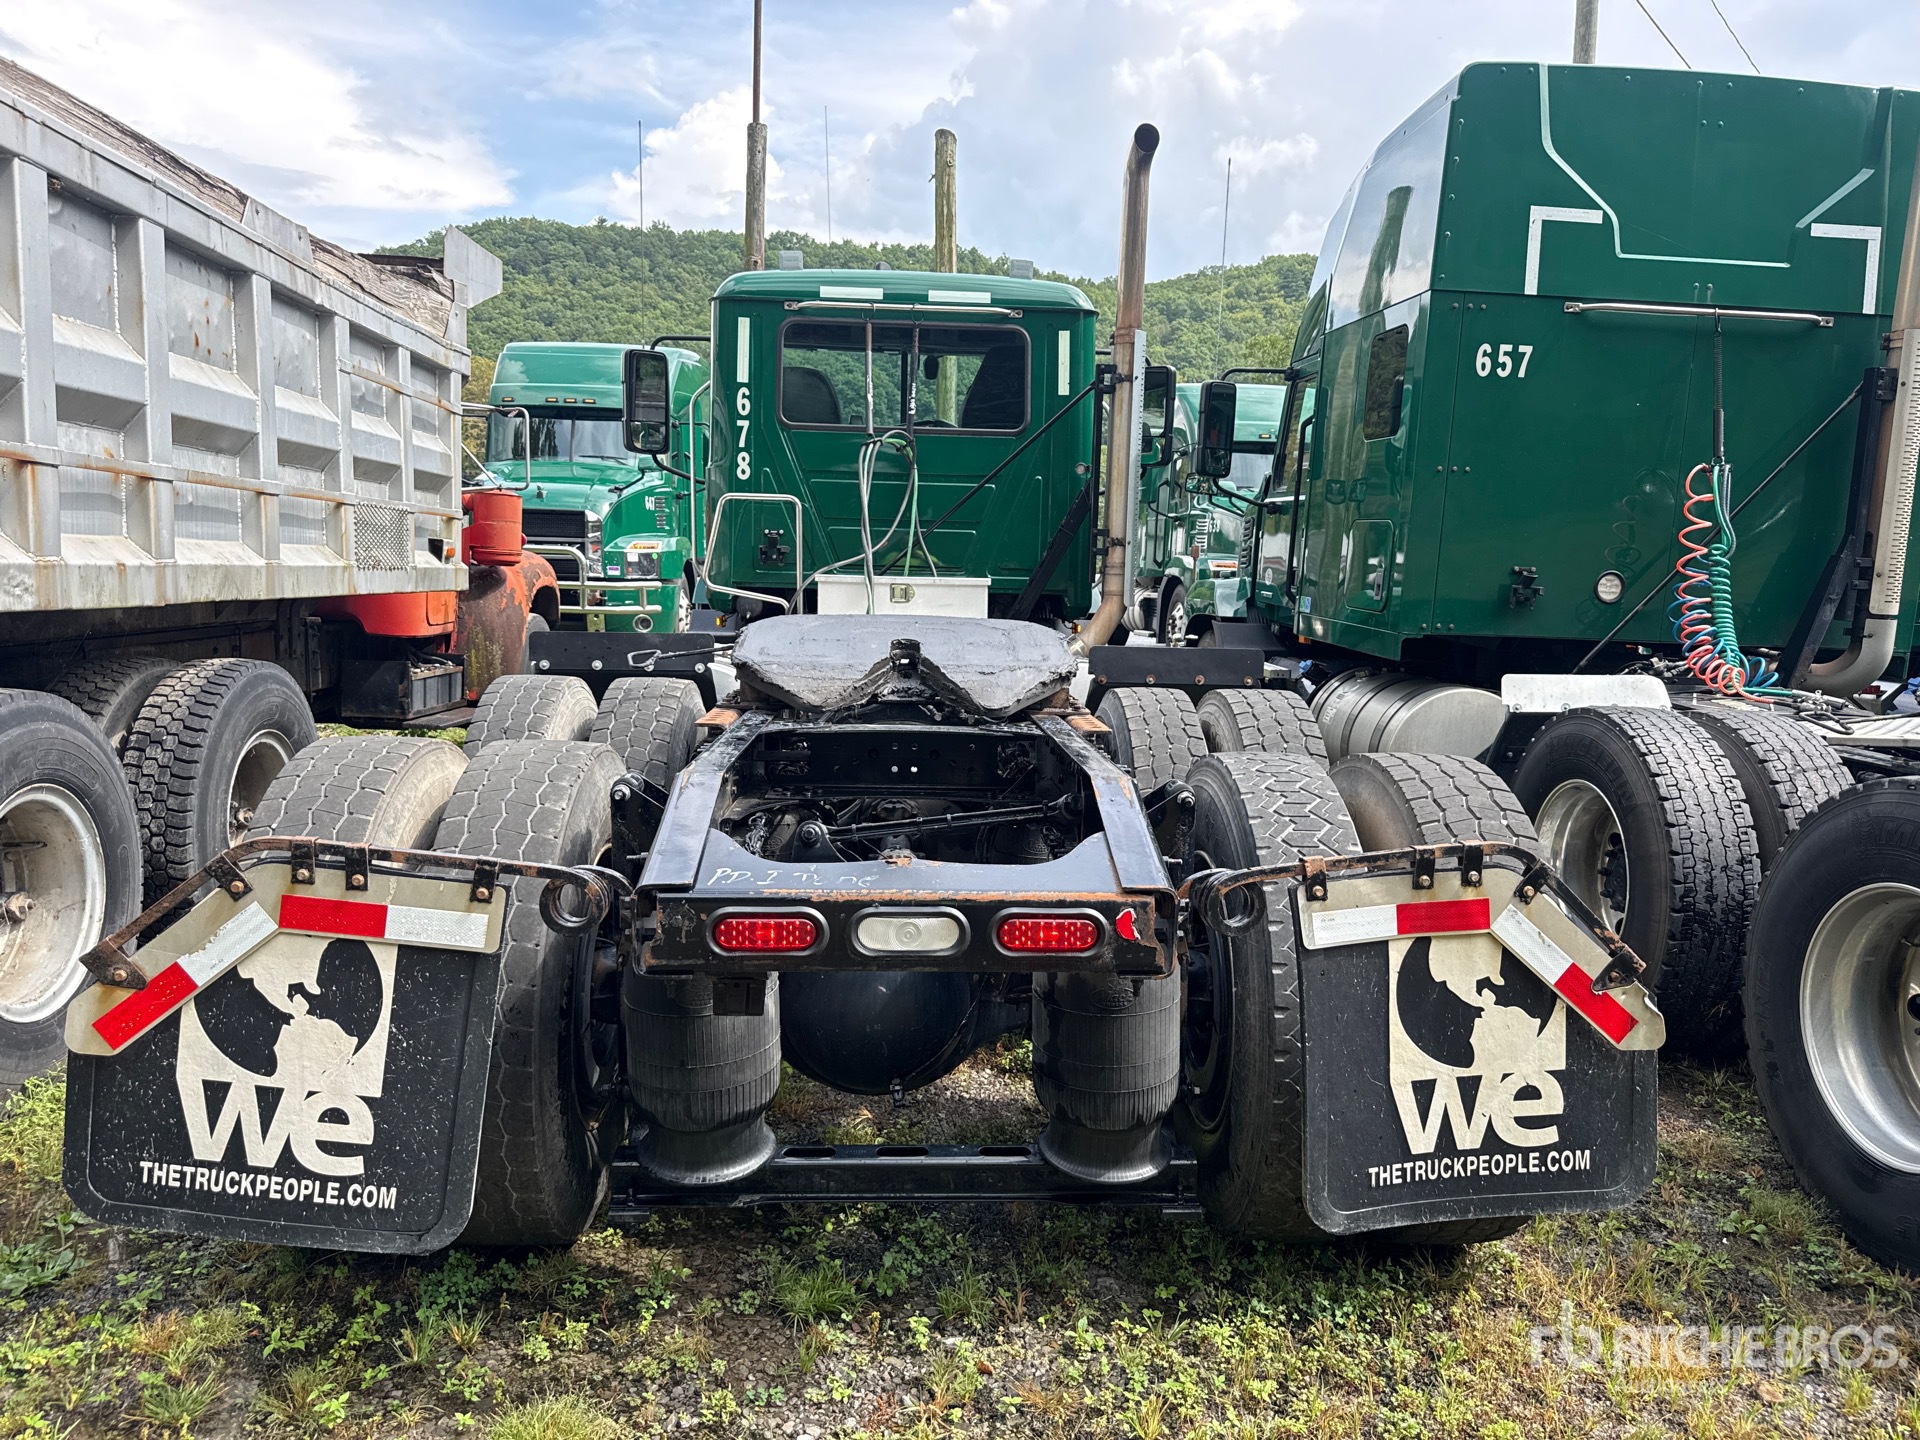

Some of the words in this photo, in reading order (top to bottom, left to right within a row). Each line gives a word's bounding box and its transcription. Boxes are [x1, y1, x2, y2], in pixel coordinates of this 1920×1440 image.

[1474, 343, 1534, 380] 657
[735, 387, 752, 480] 678
[139, 1161, 397, 1210] THETRUCKPEOPLE.COM
[1368, 1149, 1591, 1188] THETRUCKPEOPLE.COM
